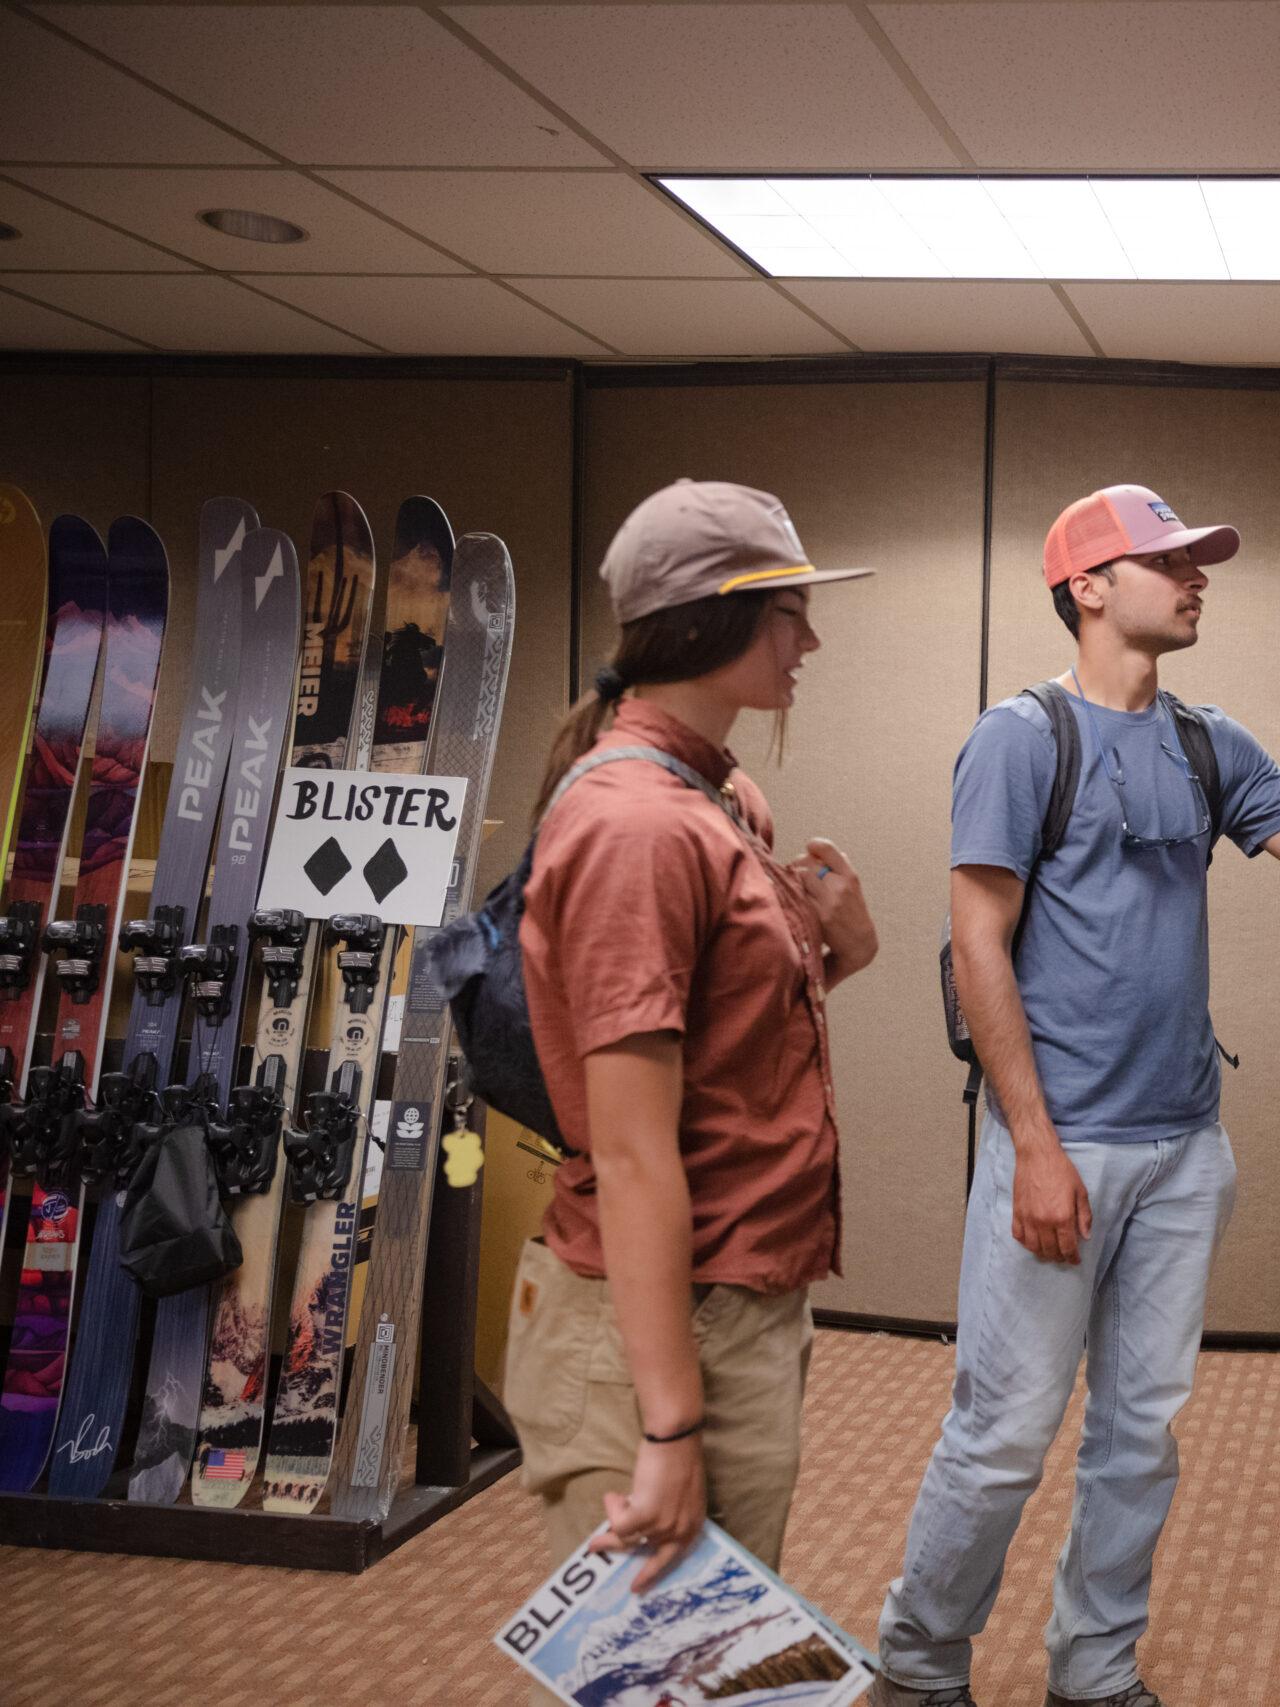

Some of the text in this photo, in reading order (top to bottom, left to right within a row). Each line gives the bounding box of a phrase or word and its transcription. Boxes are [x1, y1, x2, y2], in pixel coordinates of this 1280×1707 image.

[298, 623, 325, 717] MEIER
[177, 685, 228, 821] PEAK
[228, 715, 272, 852] PEAK
[286, 780, 457, 831] BLISTER
[322, 1201, 356, 1355] WRANGLER
[377, 1344, 390, 1395] MINDBENDER
[503, 1530, 614, 1656] BLIST
